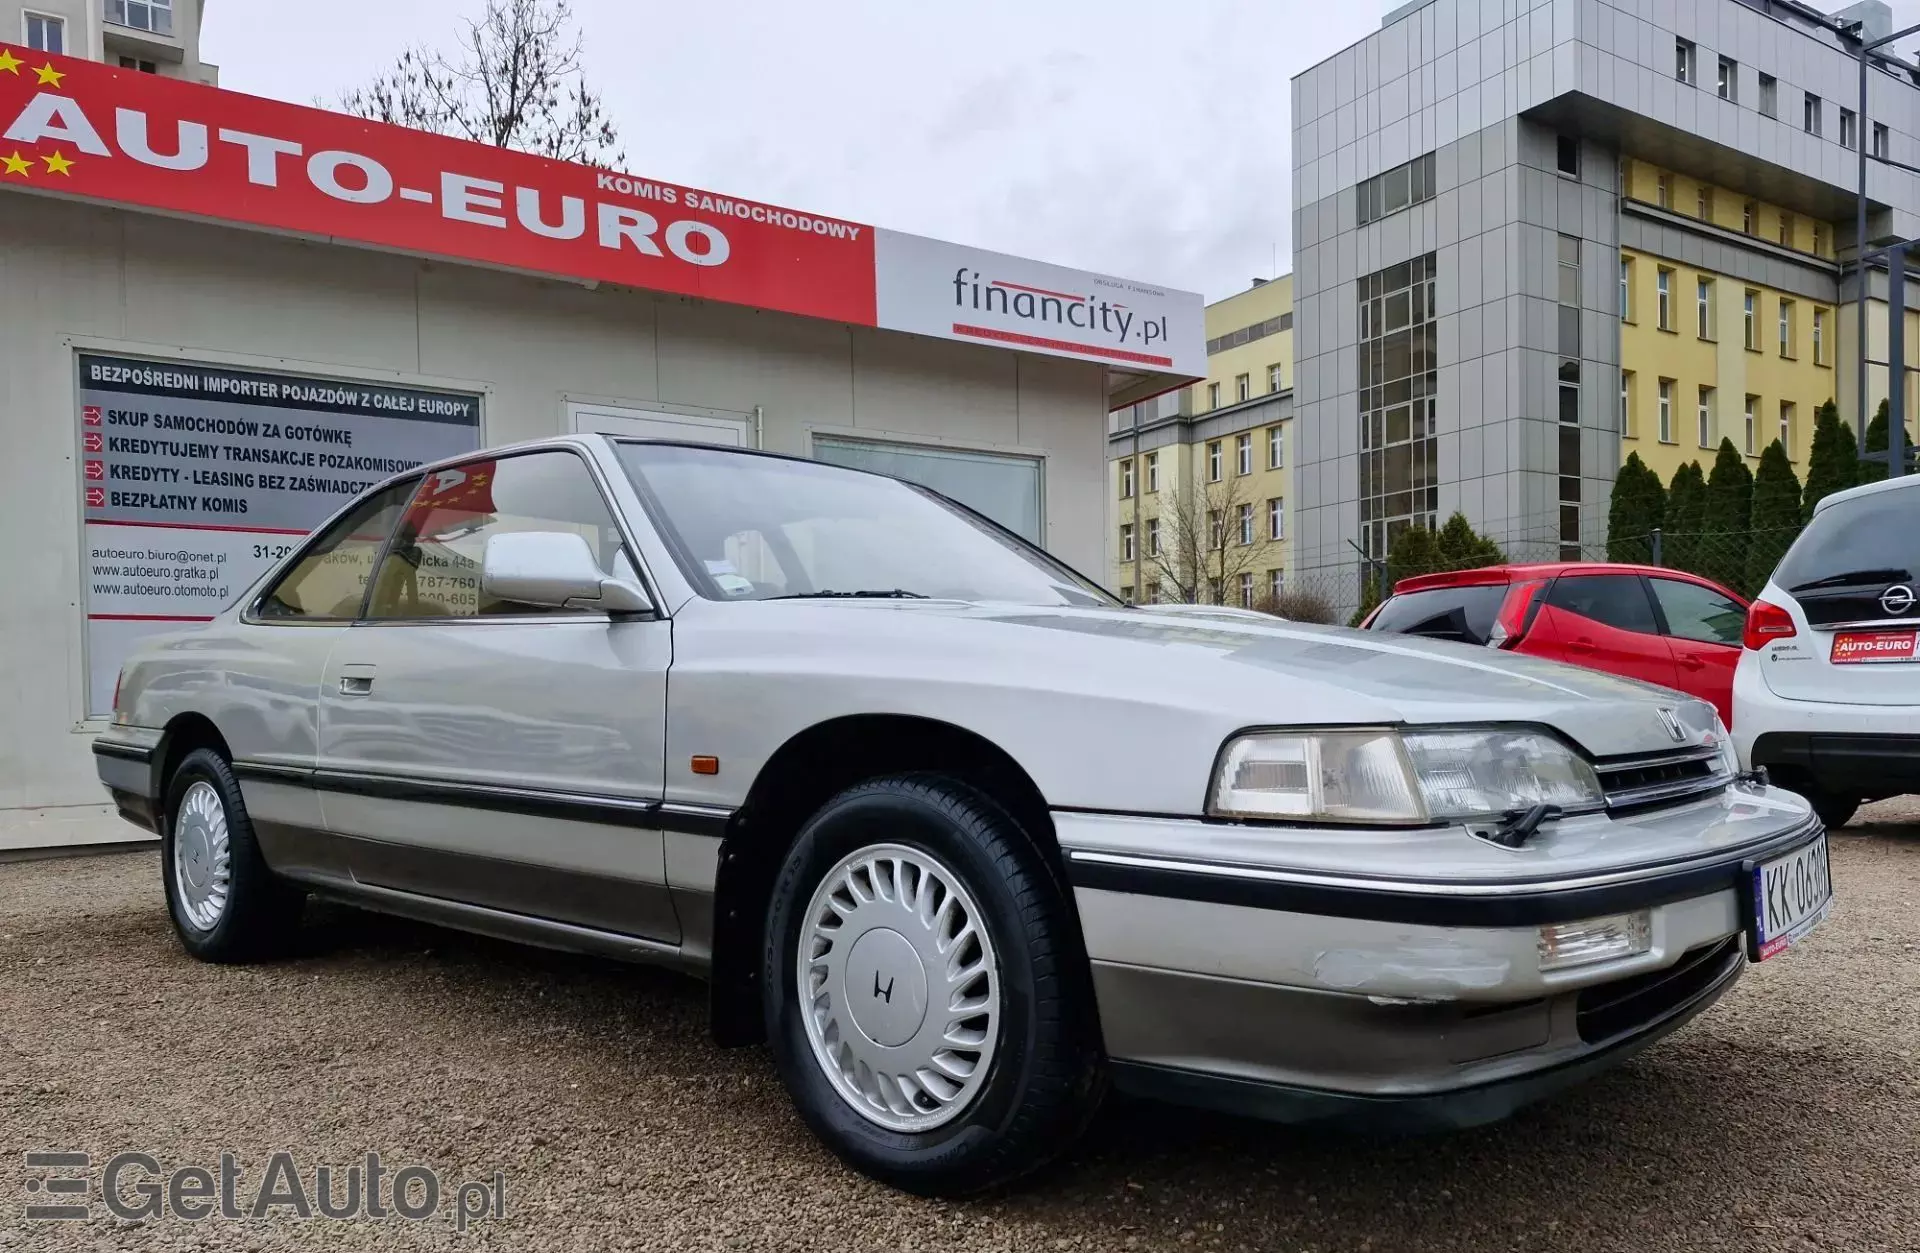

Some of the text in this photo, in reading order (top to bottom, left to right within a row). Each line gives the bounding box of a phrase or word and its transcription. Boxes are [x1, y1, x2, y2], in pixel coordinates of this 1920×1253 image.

[3, 92, 731, 267] AUTO-EURO
[597, 172, 860, 242] KOMIS SAMOCHODOWY
[953, 268, 1168, 346] financity.pl
[90, 364, 470, 417] BEZPOŚREDNI IMPORTER POJAZDÓW Z CAŁEJ EUROPY
[108, 409, 352, 448] SKUP SAMOCHODÓW ZA GOTÓWKĘ
[109, 437, 220, 459] KREDYTUJEMY
[224, 446, 315, 466] TRANSAKCJE
[110, 464, 180, 483] KREDYTY
[193, 470, 254, 488] LEASING
[258, 475, 285, 491] BEZ
[110, 491, 248, 514] BEZPŁATNY KOMIS
[91, 549, 227, 564] autoeuro.biuro@onet.pl
[93, 565, 219, 581] www.autoeuro.gratka.pl
[93, 583, 229, 600] www.autoeuro.otomoto.pl
[1840, 640, 1912, 652] AUTO-EURO
[1766, 863, 1793, 933] KK
